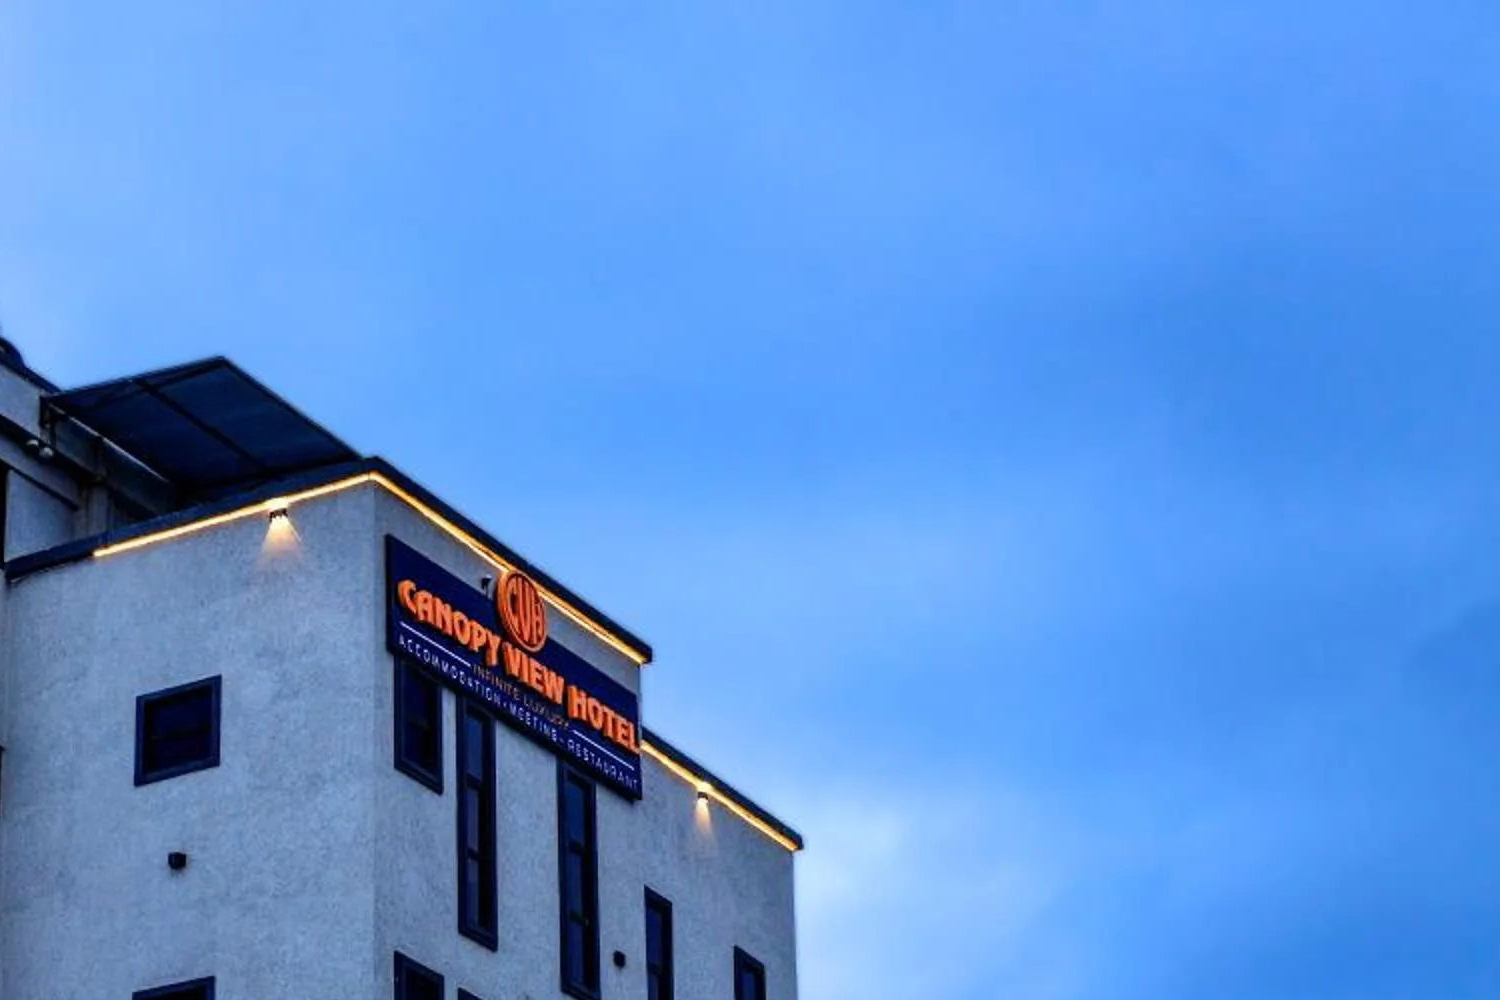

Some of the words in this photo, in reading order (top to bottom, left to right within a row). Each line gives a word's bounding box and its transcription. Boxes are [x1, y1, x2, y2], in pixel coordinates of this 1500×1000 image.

[503, 574, 544, 649] CVH
[398, 579, 501, 667] CANOPY
[503, 641, 565, 704] VIEW
[567, 684, 640, 755] HOTEL
[508, 702, 557, 743] MEETING
